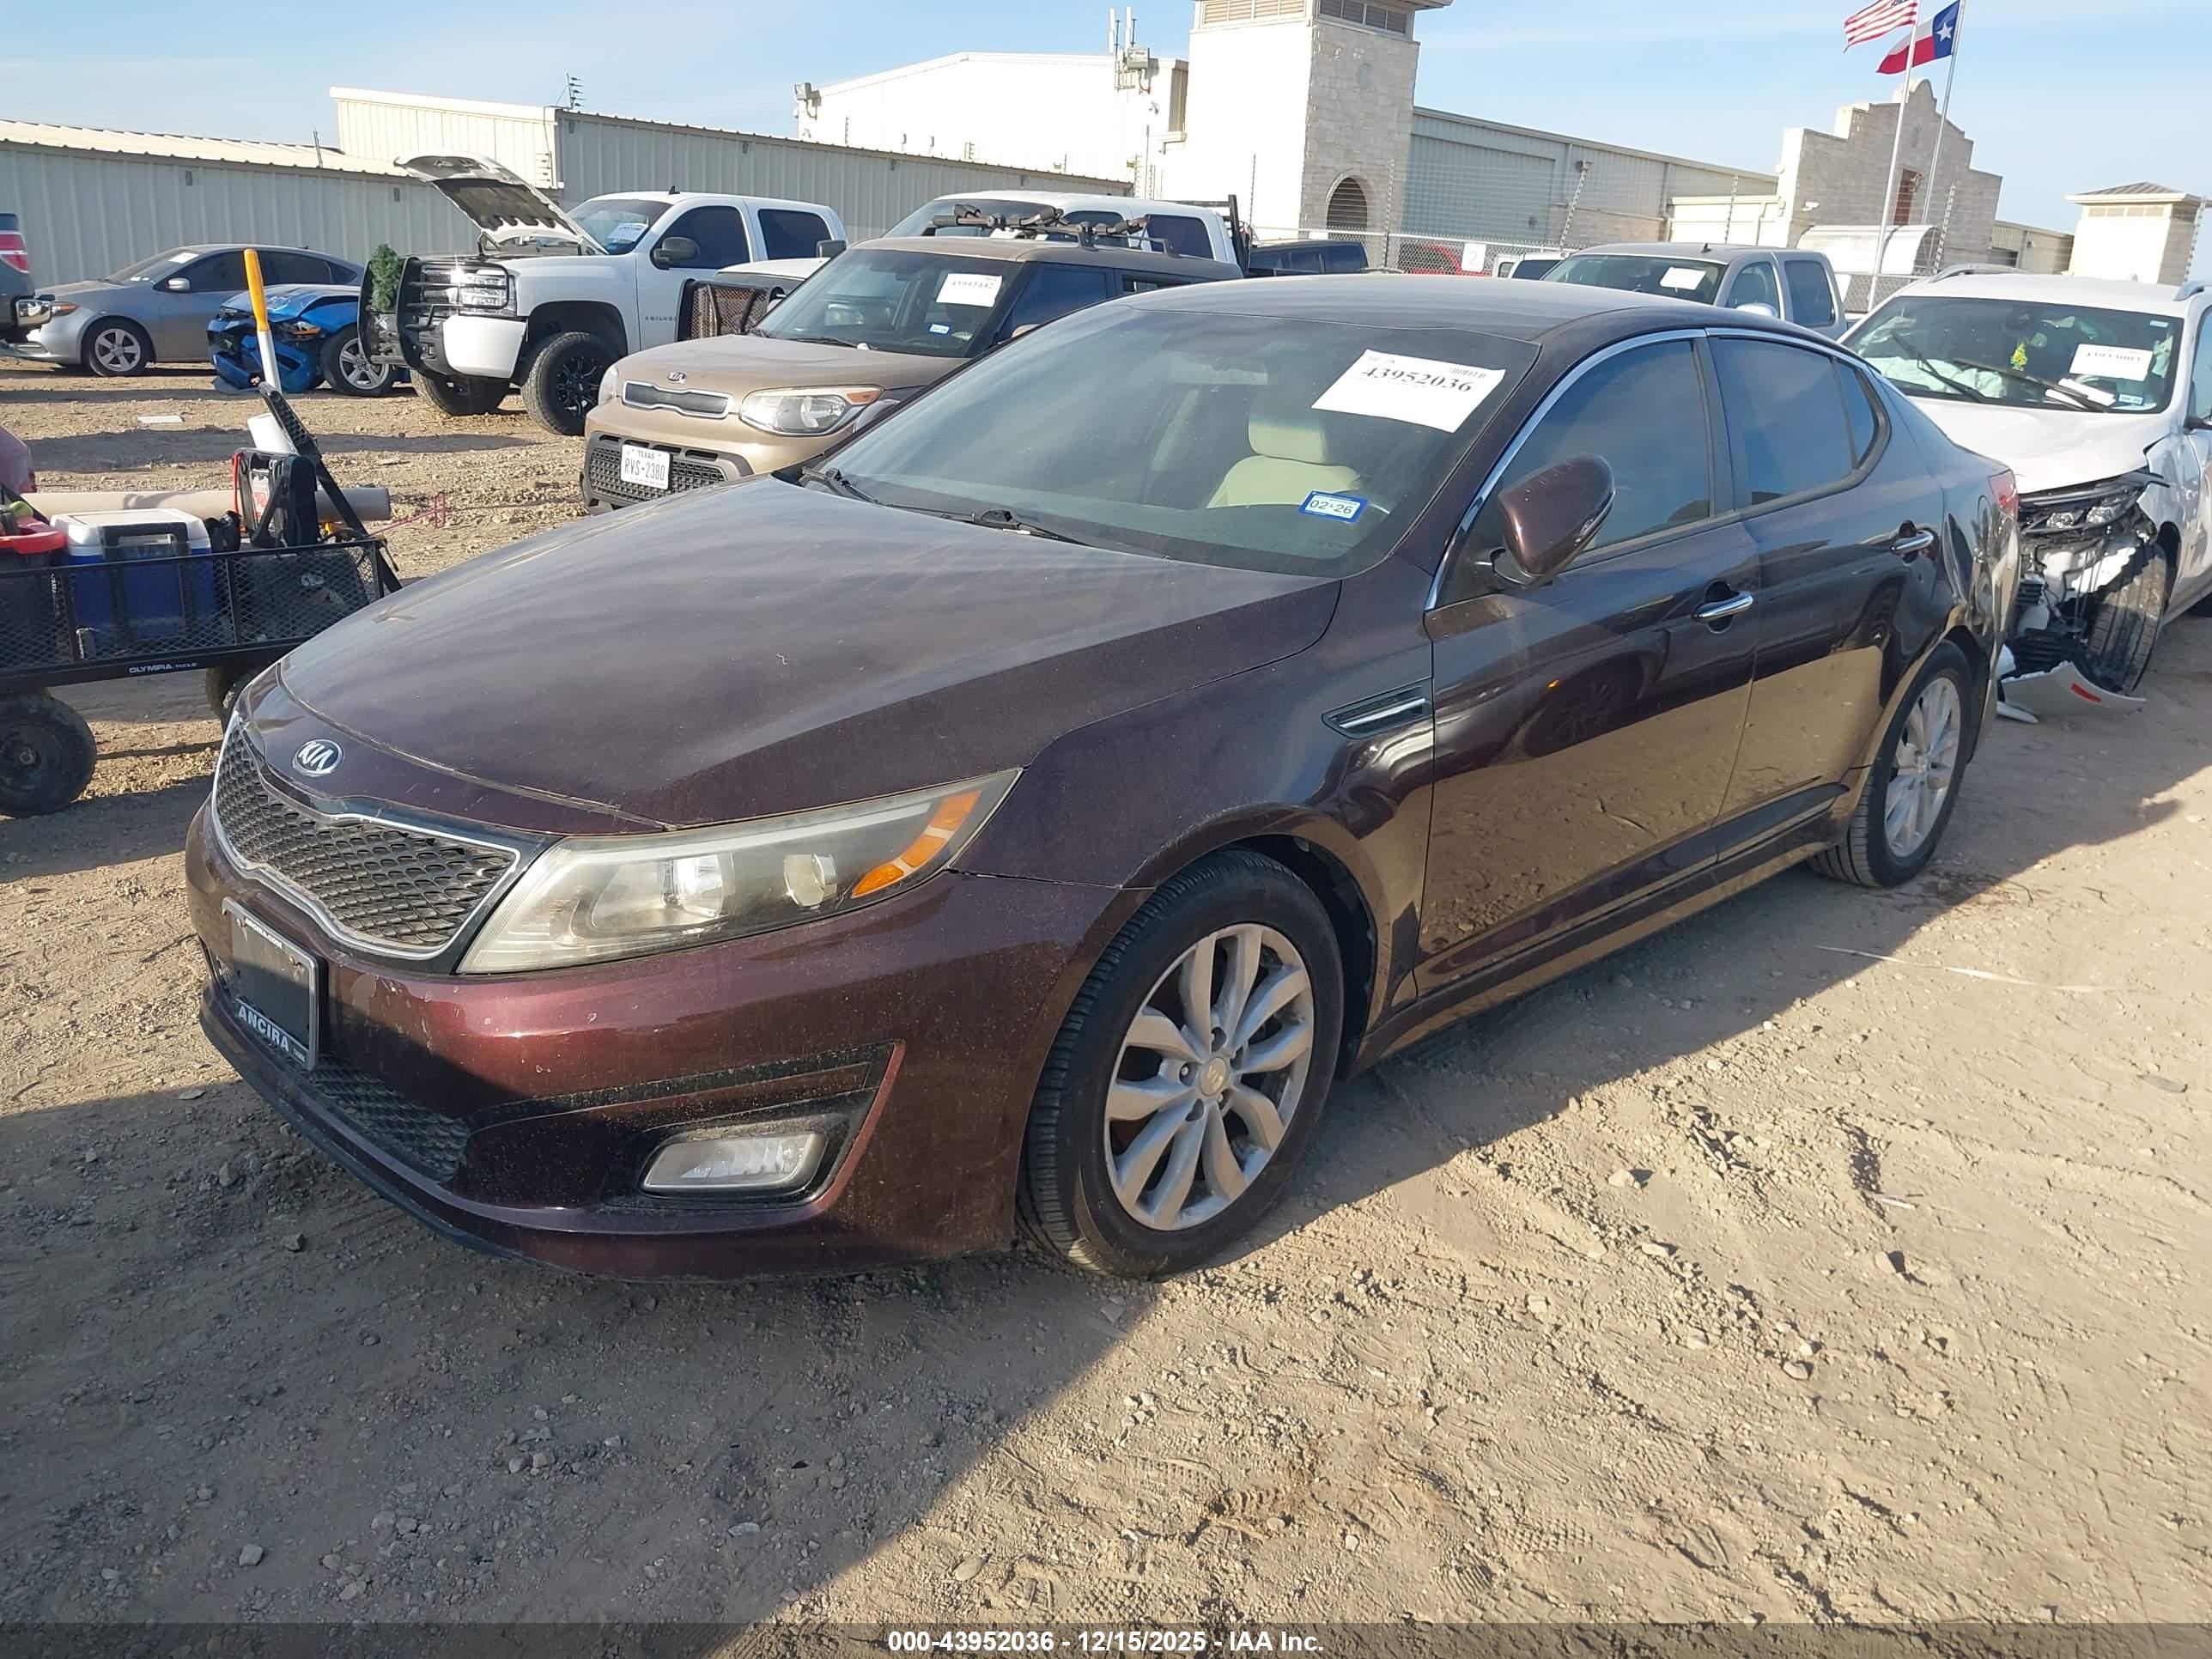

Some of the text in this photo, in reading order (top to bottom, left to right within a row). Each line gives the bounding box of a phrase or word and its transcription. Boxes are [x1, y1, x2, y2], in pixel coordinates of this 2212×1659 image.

[1362, 367, 1474, 392] 43952036
[638, 450, 655, 459] TEXAS
[129, 664, 173, 673] OLYMPIA
[298, 741, 334, 771] KIA
[239, 1006, 289, 1052] ANCIRA
